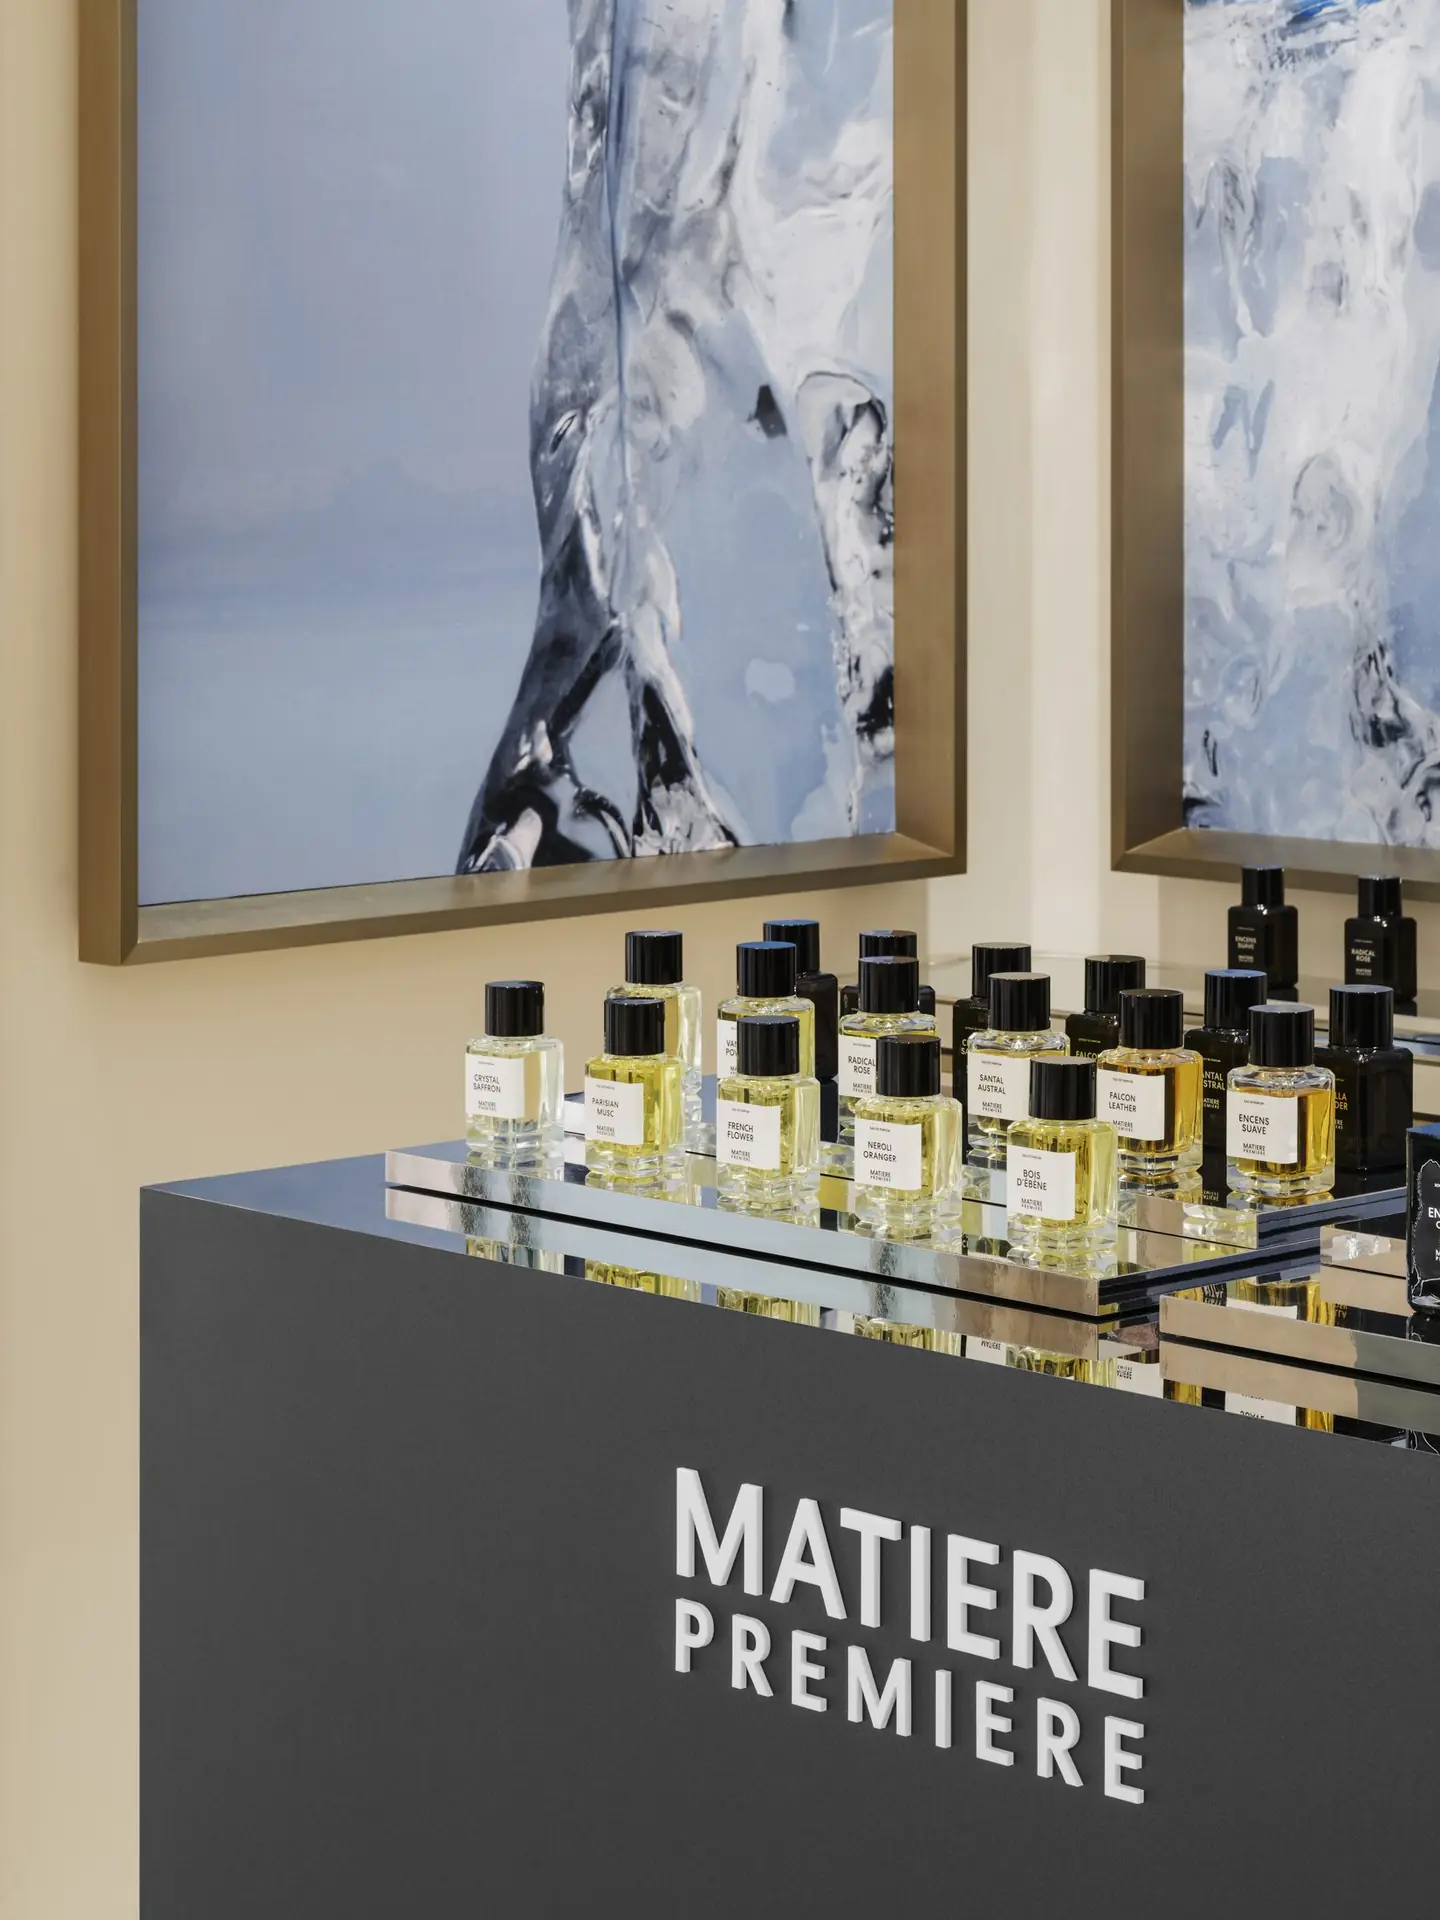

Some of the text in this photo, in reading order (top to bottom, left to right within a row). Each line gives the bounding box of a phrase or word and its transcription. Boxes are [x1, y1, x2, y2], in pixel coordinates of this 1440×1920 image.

[848, 1055, 876, 1067] RADICAL
[854, 1065, 871, 1075] ROSE
[474, 1074, 500, 1085] CRYSTAL
[980, 1074, 1004, 1085] SANTAL
[473, 1083, 501, 1093] SAFFRON
[978, 1084, 1006, 1095] AUSTRAL
[1203, 1080, 1226, 1091] STRAL
[592, 1097, 619, 1108] PARISIAN
[1110, 1092, 1136, 1102] FALCON
[1109, 1101, 1137, 1113] LEATHER
[597, 1108, 615, 1118] MUSC
[1239, 1113, 1270, 1126] ENCENS
[728, 1121, 754, 1133] FRENCH
[1242, 1124, 1267, 1135] SUAVE
[728, 1130, 754, 1142] FLOWER
[868, 1141, 892, 1152] NEROLI
[1243, 1143, 1266, 1152] MATIERE
[863, 1151, 897, 1163] ORANGER
[870, 1169, 891, 1178] MATIERE
[1023, 1169, 1041, 1180] BOIS
[1021, 1198, 1042, 1207] MATIERE
[675, 1466, 1146, 1699] MATIERE
[675, 1597, 1146, 1805] PREMIERE
